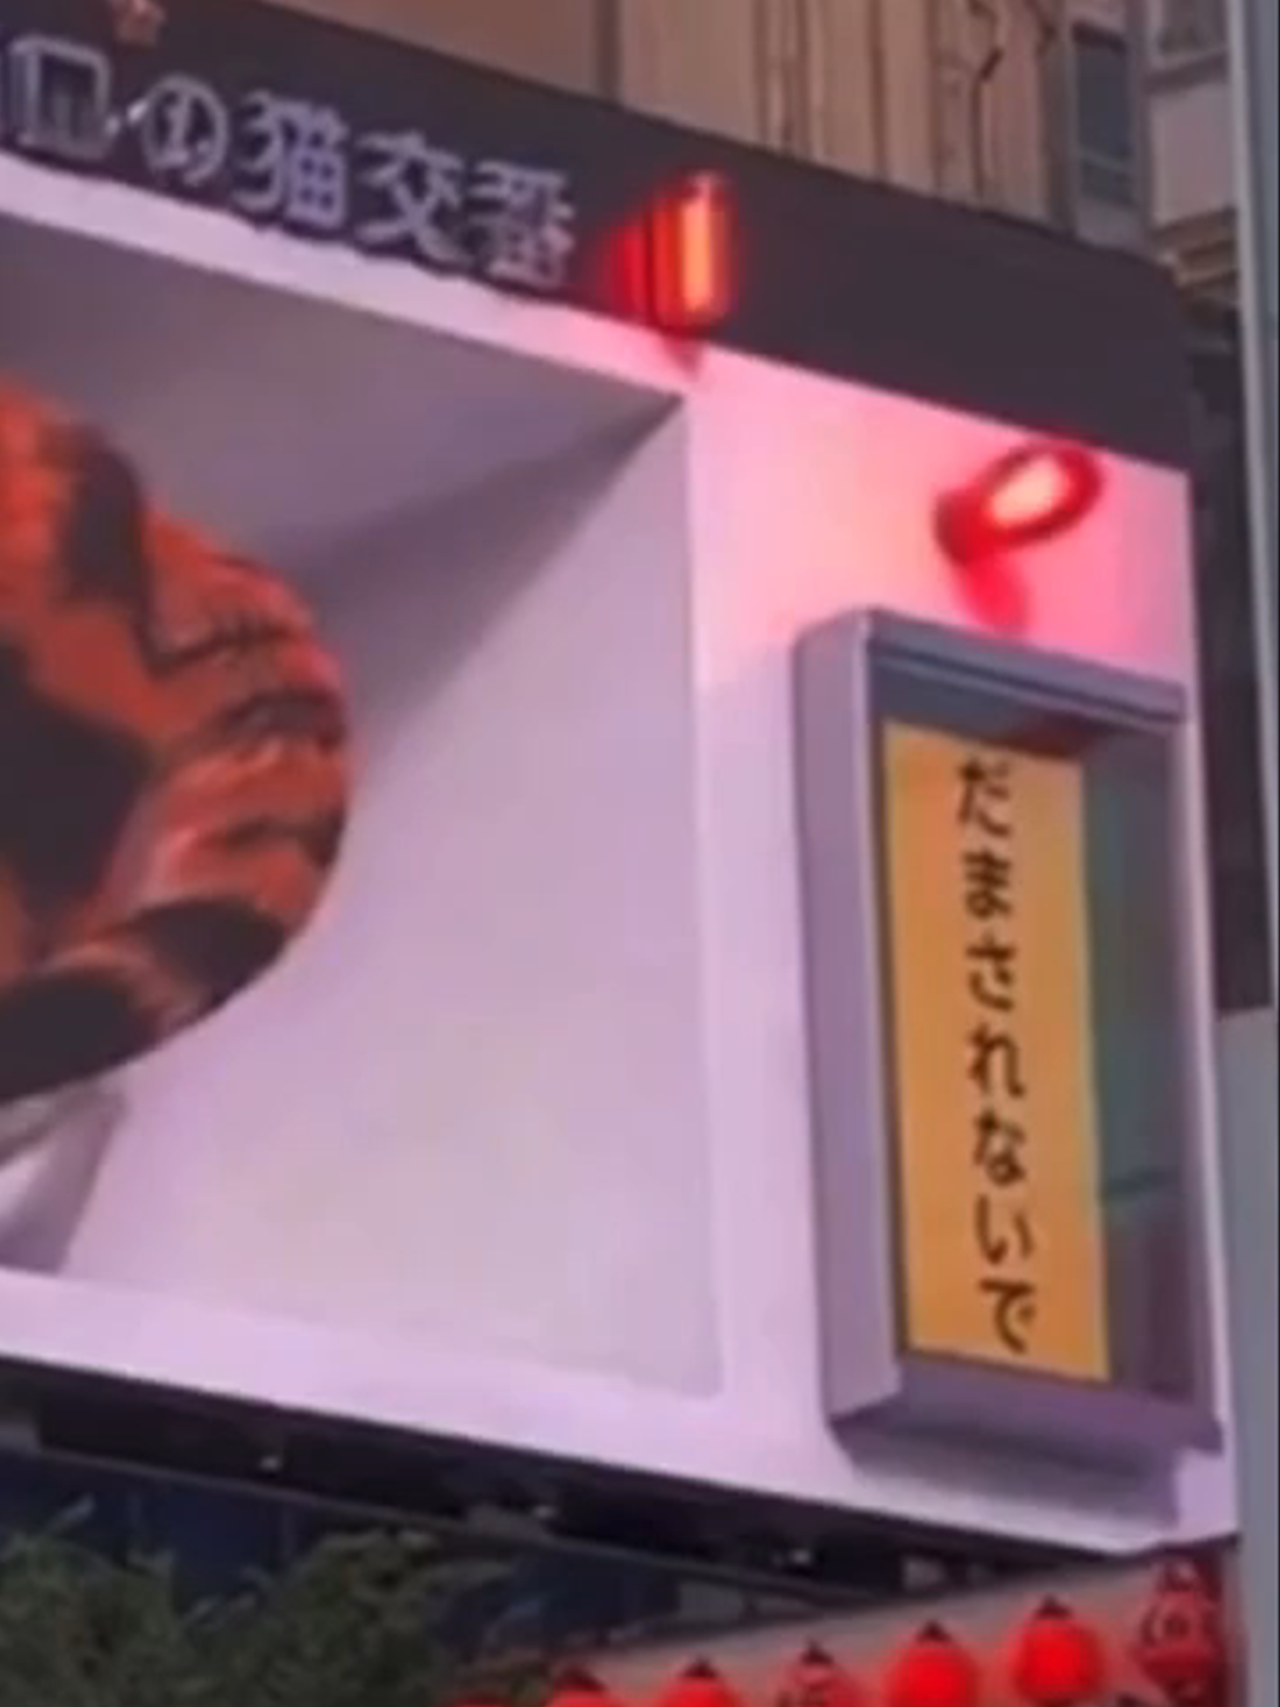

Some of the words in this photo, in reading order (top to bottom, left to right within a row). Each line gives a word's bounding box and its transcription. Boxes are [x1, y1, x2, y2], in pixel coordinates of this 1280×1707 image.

[954, 754, 1037, 1356] だまされないで
